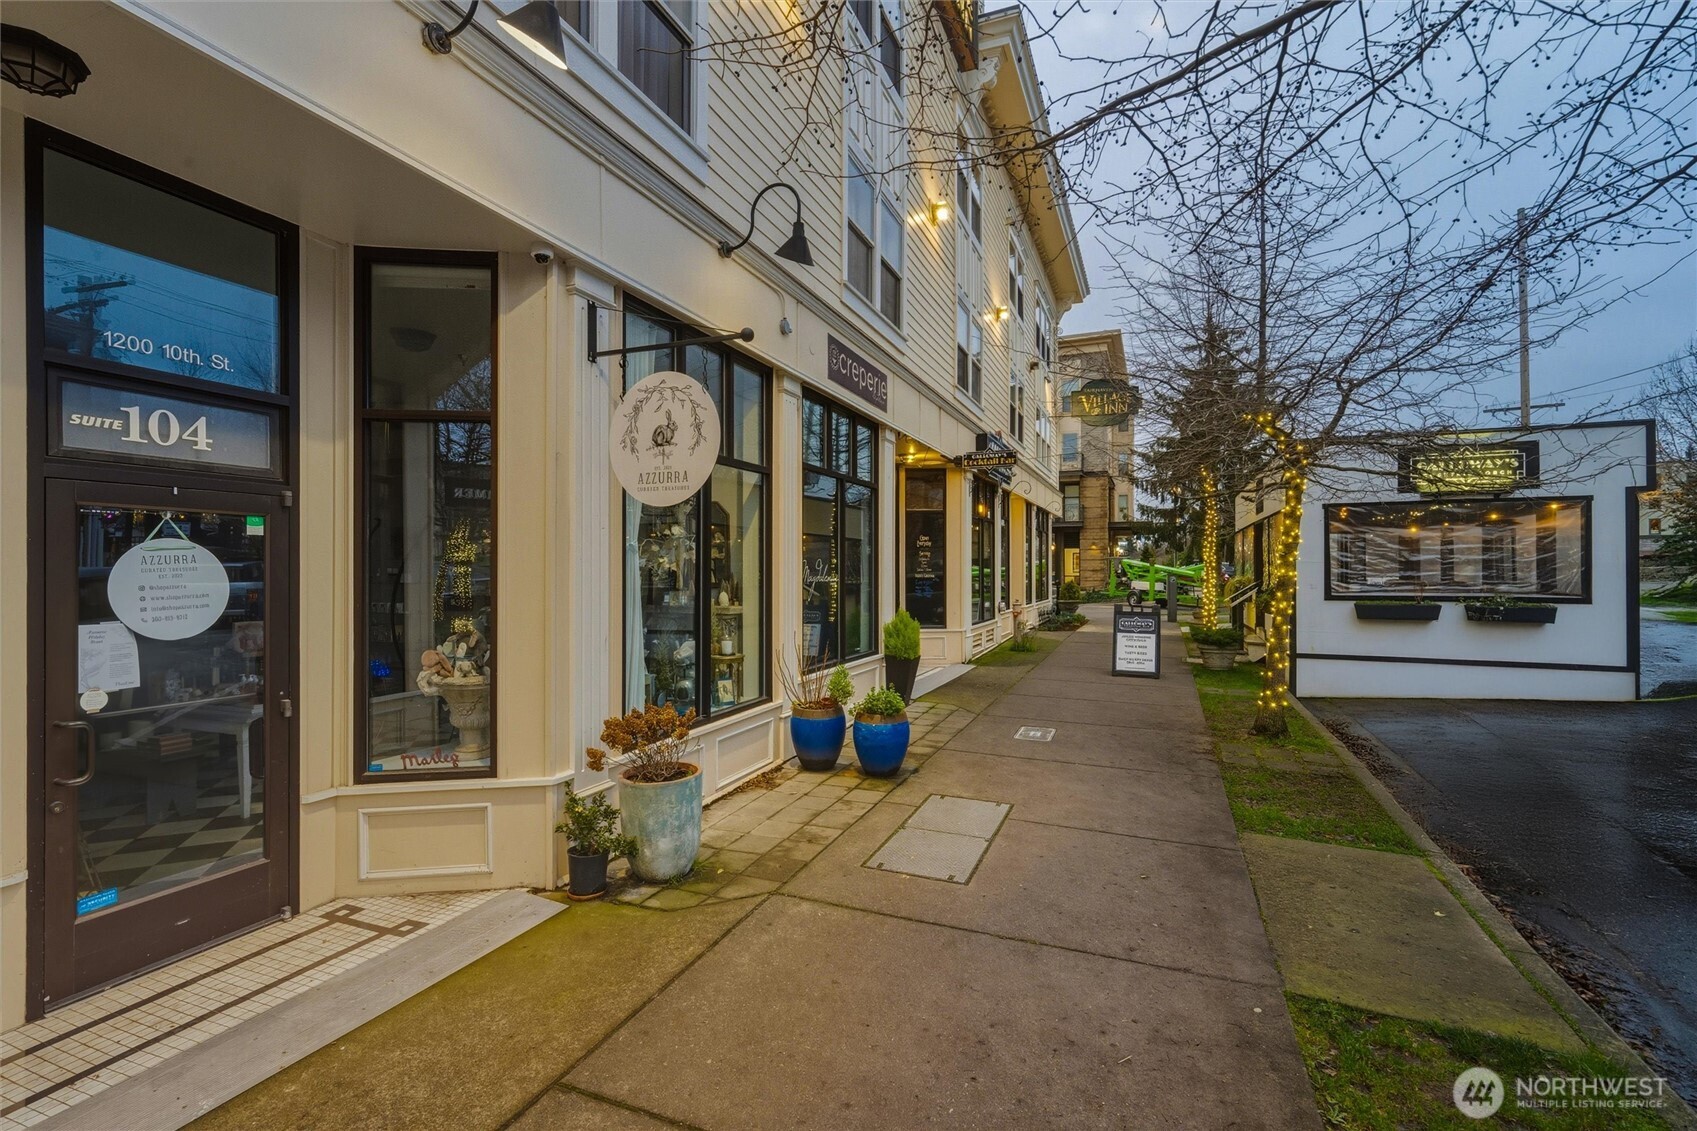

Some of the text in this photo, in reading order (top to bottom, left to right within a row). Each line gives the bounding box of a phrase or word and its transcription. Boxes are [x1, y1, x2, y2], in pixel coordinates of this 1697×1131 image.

[103, 331, 234, 372] 1200 10th. St.
[839, 353, 887, 400] creperie
[1104, 402, 1129, 415] INN
[69, 406, 213, 451] SUITE 104
[638, 470, 688, 485] AZZURRA
[140, 554, 197, 566] AZZURRA
